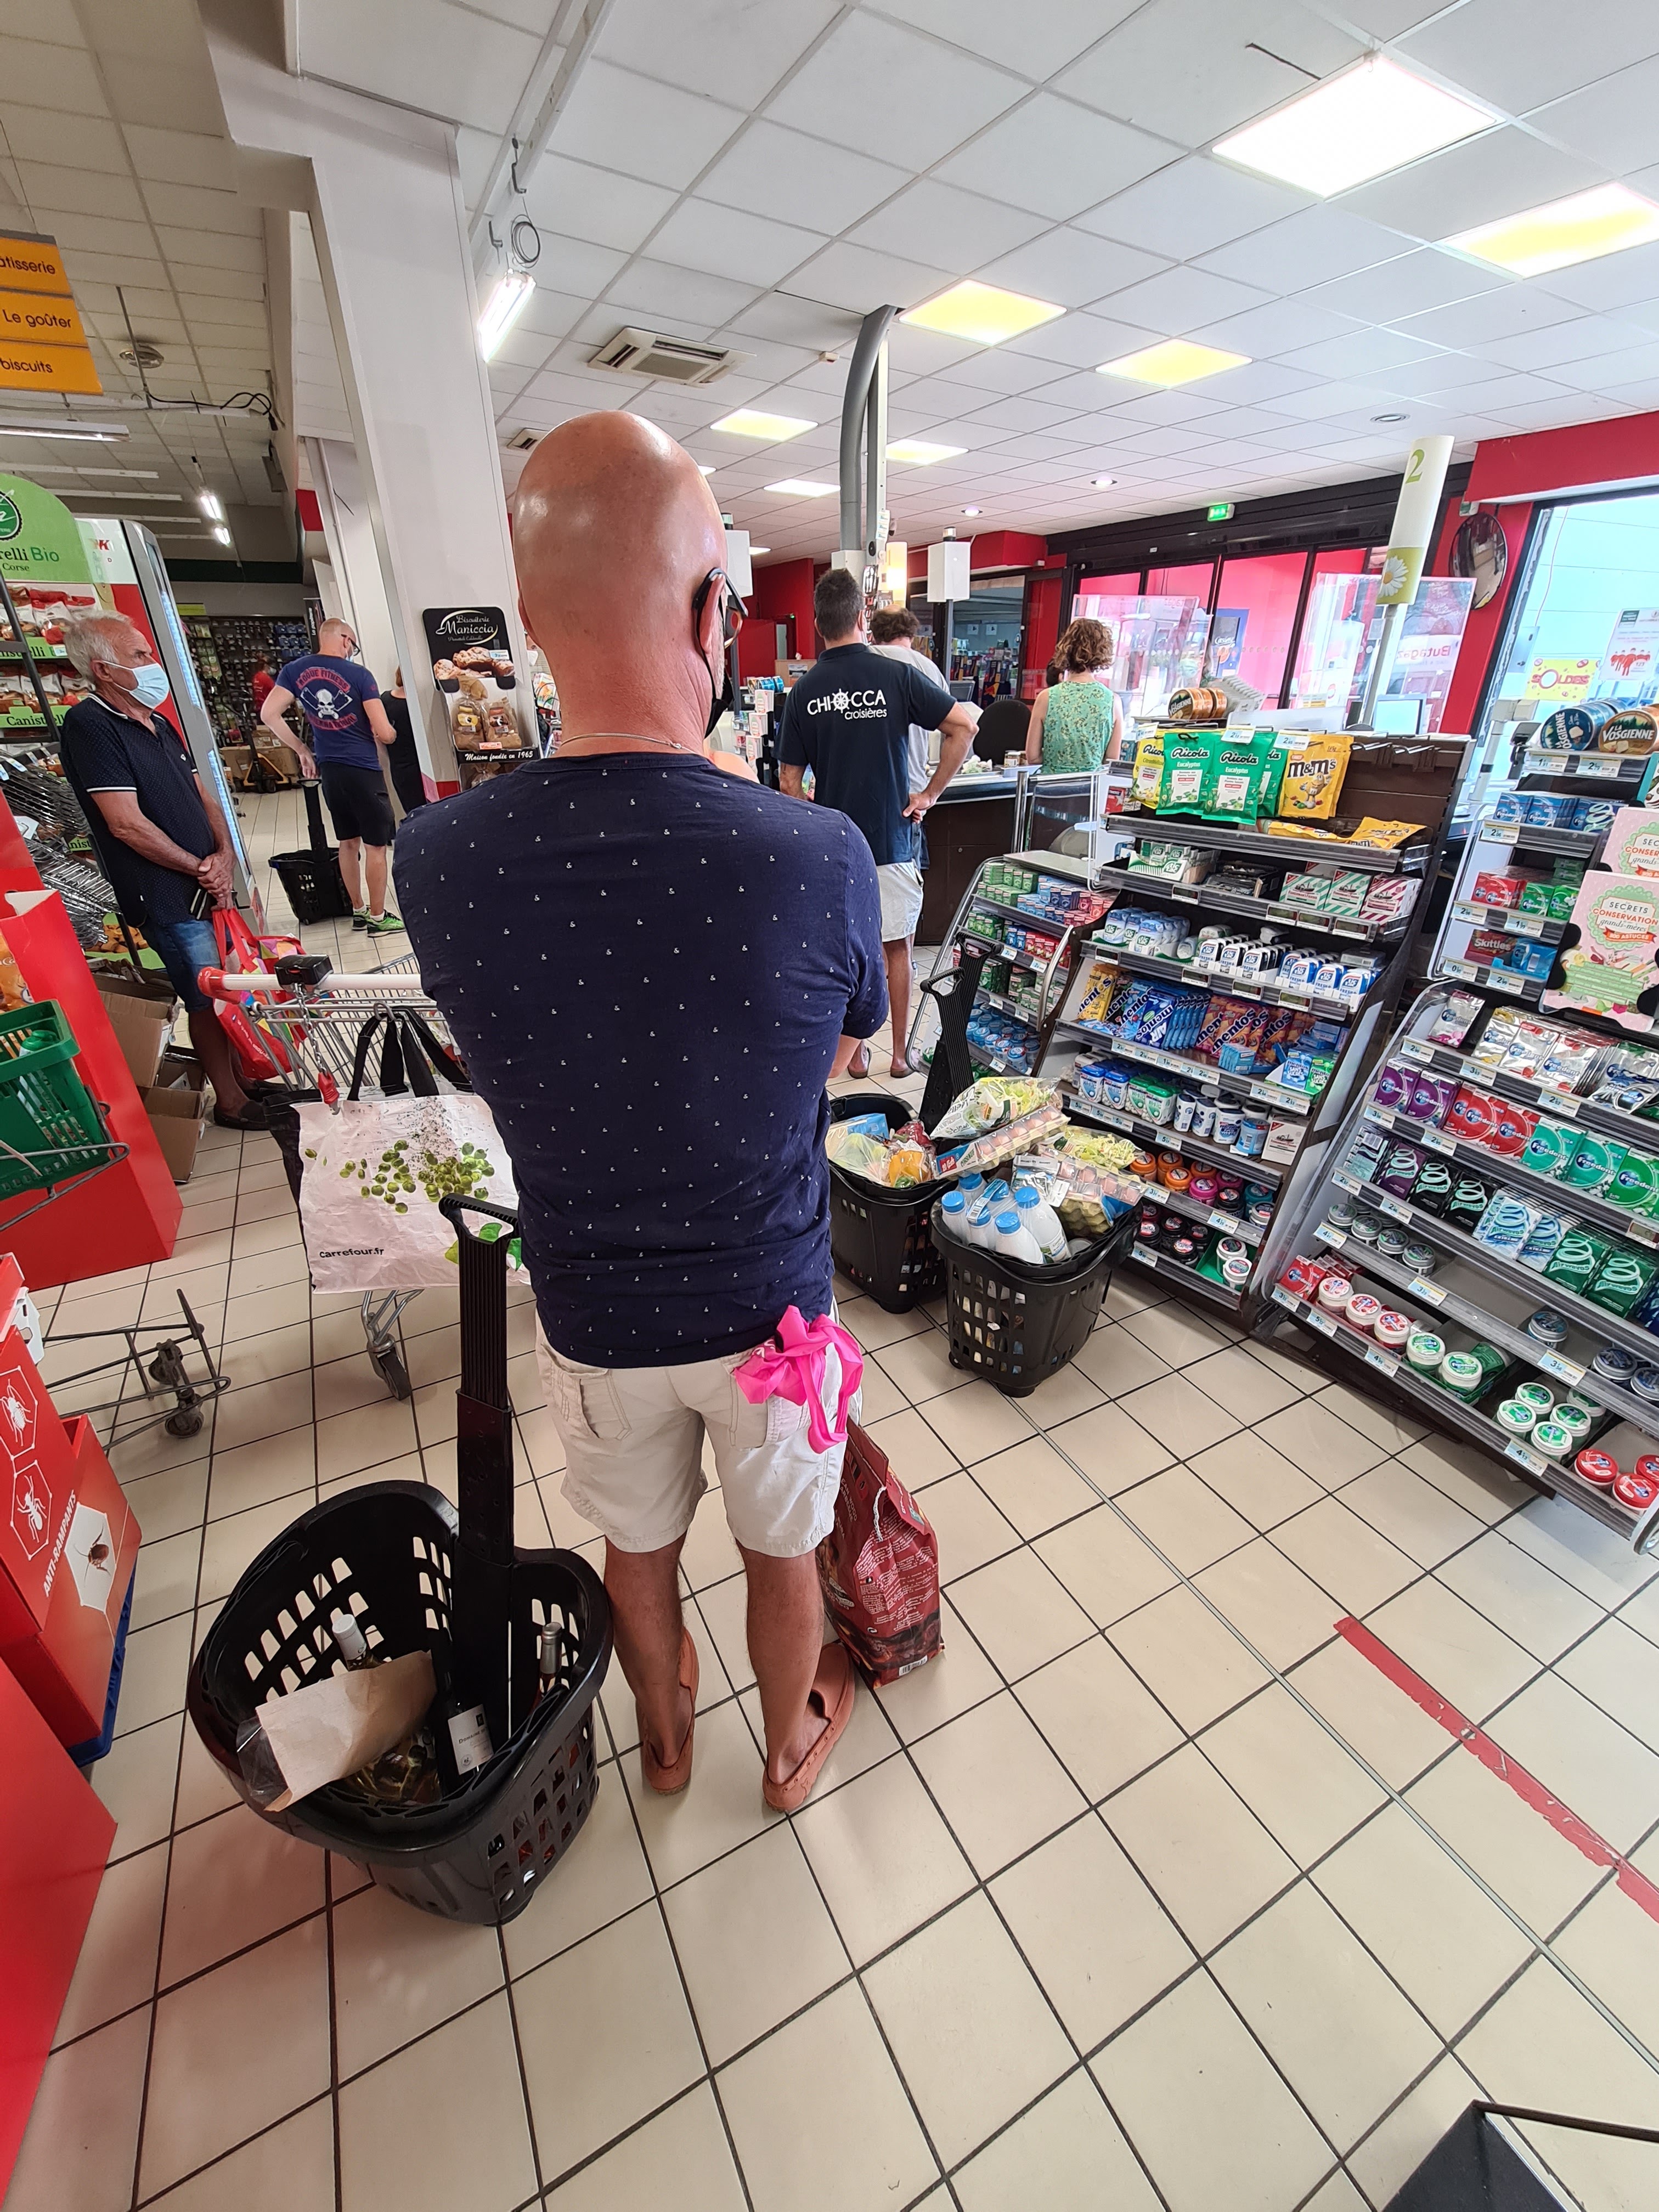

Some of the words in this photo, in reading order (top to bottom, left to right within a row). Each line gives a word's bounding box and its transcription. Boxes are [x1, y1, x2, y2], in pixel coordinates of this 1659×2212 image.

[3, 309, 21, 323] Le
[26, 313, 71, 328] goûter
[1, 359, 53, 373] biscuits
[1406, 449, 1426, 484] 2
[30, 546, 59, 562] Bio
[2, 563, 30, 572] Corse
[456, 614, 490, 623] Biscuiterie
[436, 620, 494, 635] Maniccia
[321, 669, 349, 690] FITNESS
[1531, 669, 1590, 689] SOLDES
[844, 708, 887, 720] croisières
[1555, 712, 1572, 749] OSGIENNE
[1602, 726, 1655, 743] VOSGIENNE
[489, 752, 507, 761] fondée
[1172, 747, 1209, 758] Ricola
[1221, 751, 1258, 764] Ricola
[1610, 901, 1649, 914] SECRETS
[1593, 908, 1658, 926] CONSERVATION
[1600, 919, 1646, 932] grands-mères
[1474, 938, 1511, 951] Skittles
[1212, 1009, 1256, 1052] mentos
[1545, 1059, 1580, 1075] Freedent
[1382, 1080, 1409, 1096] Freedent
[1415, 1093, 1444, 1109] Freedent
[1466, 1110, 1498, 1128] Freedent
[1532, 1143, 1568, 1161] Freedent
[1577, 1156, 1616, 1176] Freedent
[1620, 1173, 1659, 1193] Freedent
[319, 1248, 384, 1259] carrefour.fr
[1550, 1260, 1590, 1272] Airwaves
[1598, 1280, 1638, 1291] Airwaves
[43, 1489, 76, 1597] ANTI-RAMPANTS
